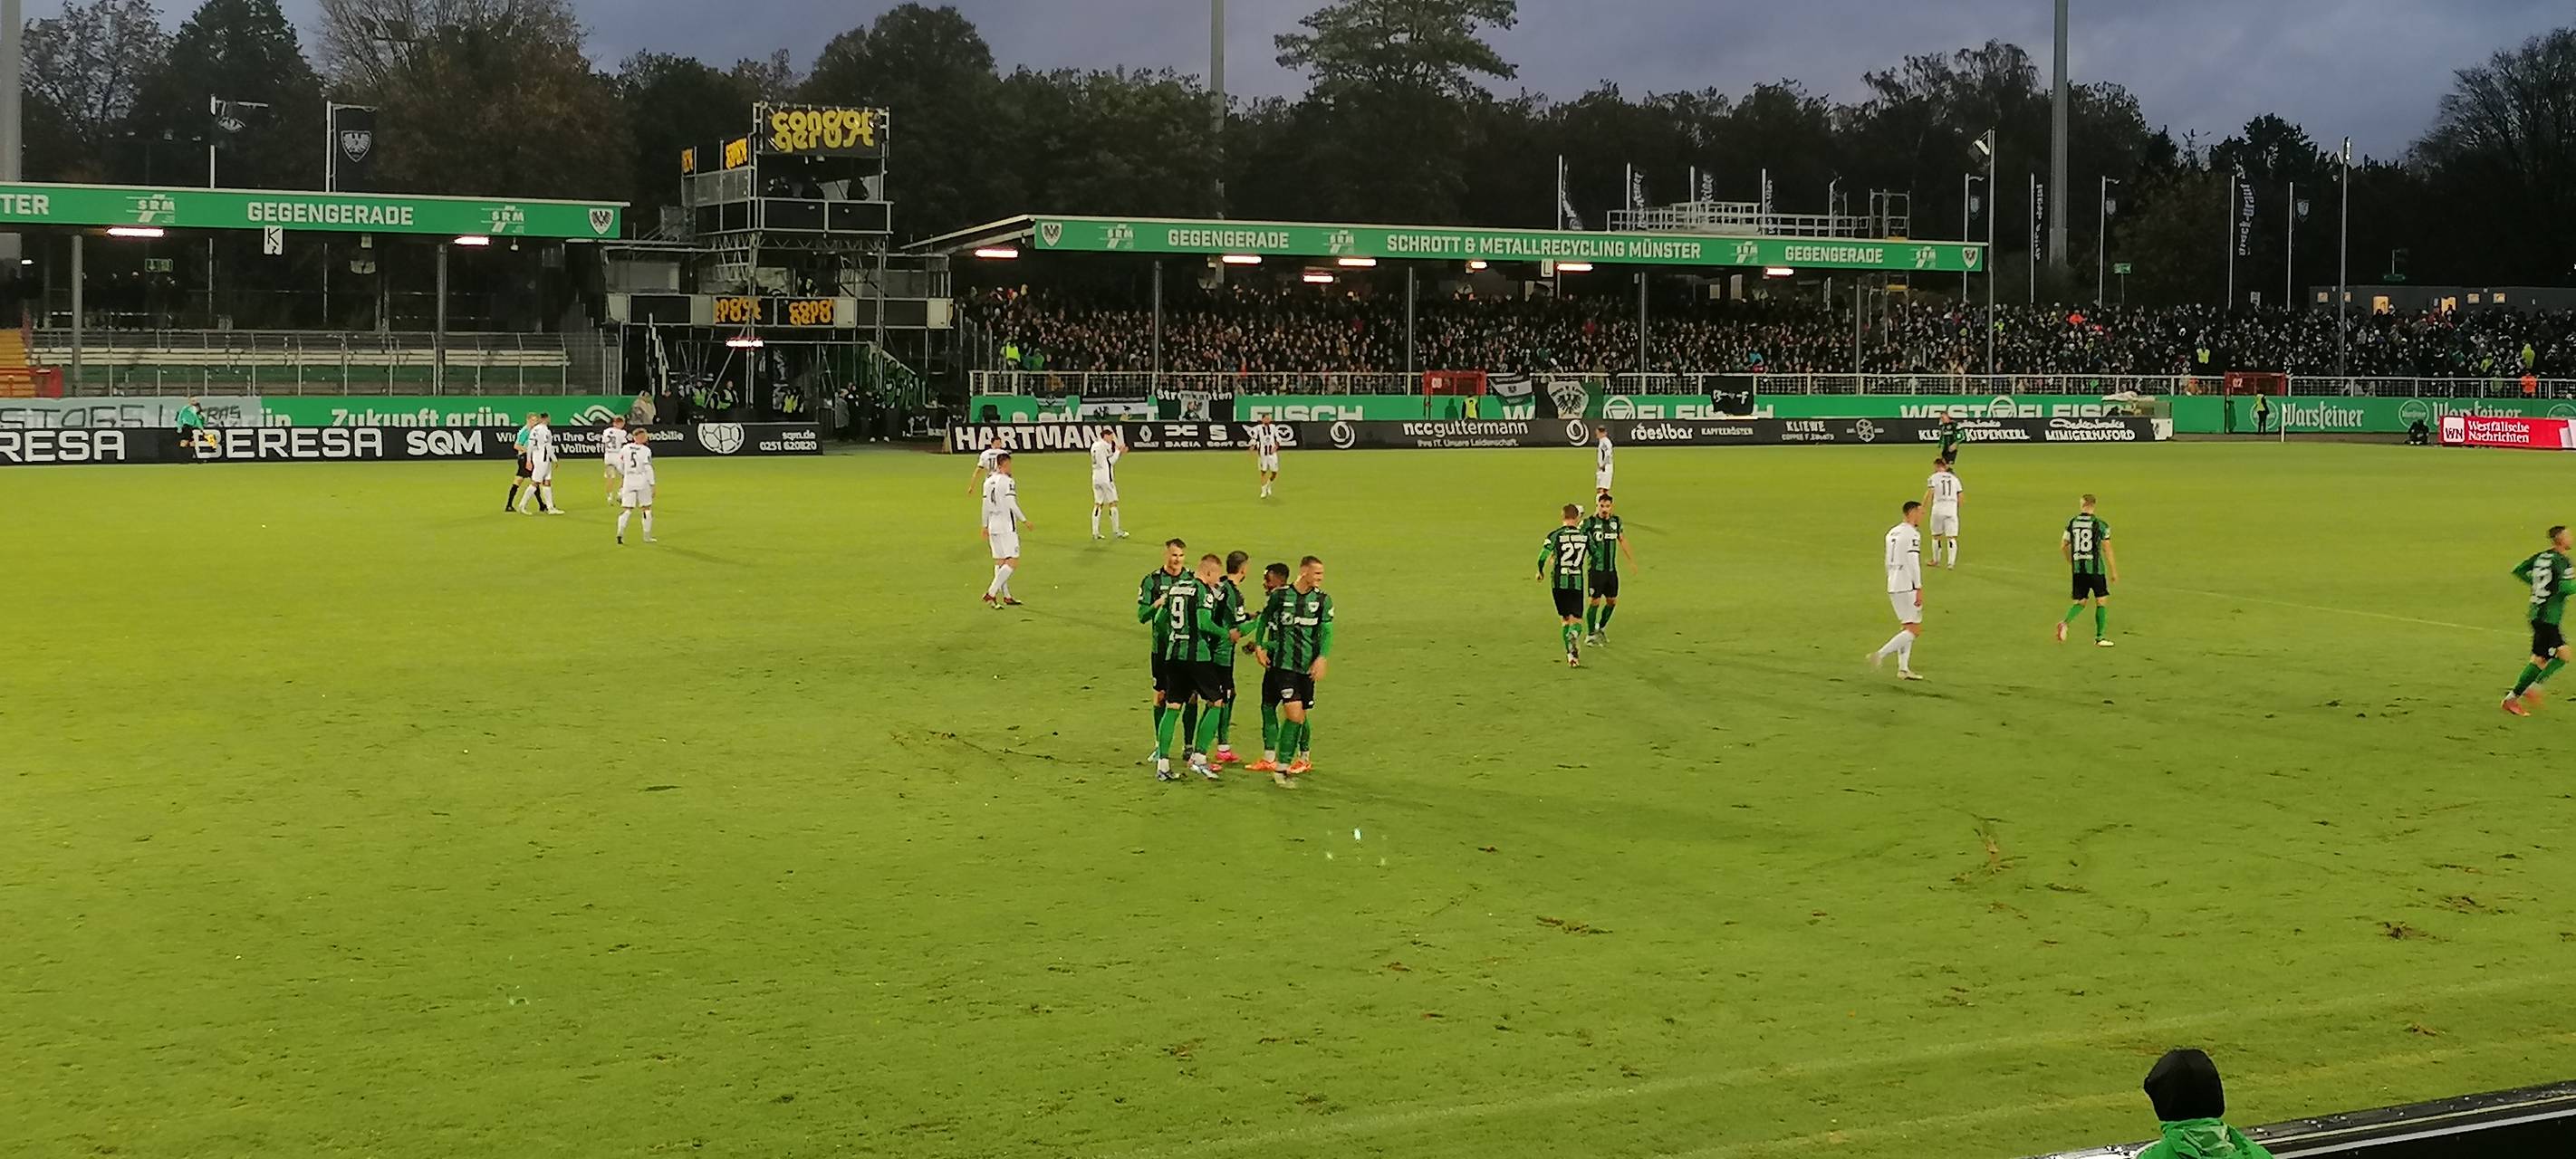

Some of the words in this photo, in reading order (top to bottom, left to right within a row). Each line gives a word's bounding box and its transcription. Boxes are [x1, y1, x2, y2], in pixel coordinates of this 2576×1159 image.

[0, 194, 50, 215] TER
[247, 202, 414, 225] GEGENGERADE
[267, 227, 280, 244] K
[1168, 229, 1289, 248] GEGENGERADE
[1387, 235, 1461, 253] SCHROTT
[1464, 236, 1475, 253] &
[1480, 236, 1624, 257] METALLRECYCLING
[1629, 238, 1701, 259] MÜNSTER
[1784, 245, 1884, 263] GEGENGERADE
[332, 407, 439, 427] Zukunft
[2283, 401, 2365, 430] Warsteiner
[192, 427, 383, 459] BERESA
[406, 429, 484, 455] SQM
[782, 430, 816, 441] sqm.de
[955, 425, 1125, 451] HARTMANN
[2446, 427, 2464, 440] WN
[2468, 431, 2530, 444] Nachrichten
[0, 430, 125, 462] RESA
[759, 441, 782, 451] 0251
[630, 451, 637, 468] 5
[1941, 479, 1952, 496] 11
[2073, 529, 2093, 552] 18
[1560, 542, 1586, 567] 27
[1170, 596, 1186, 629] 9
